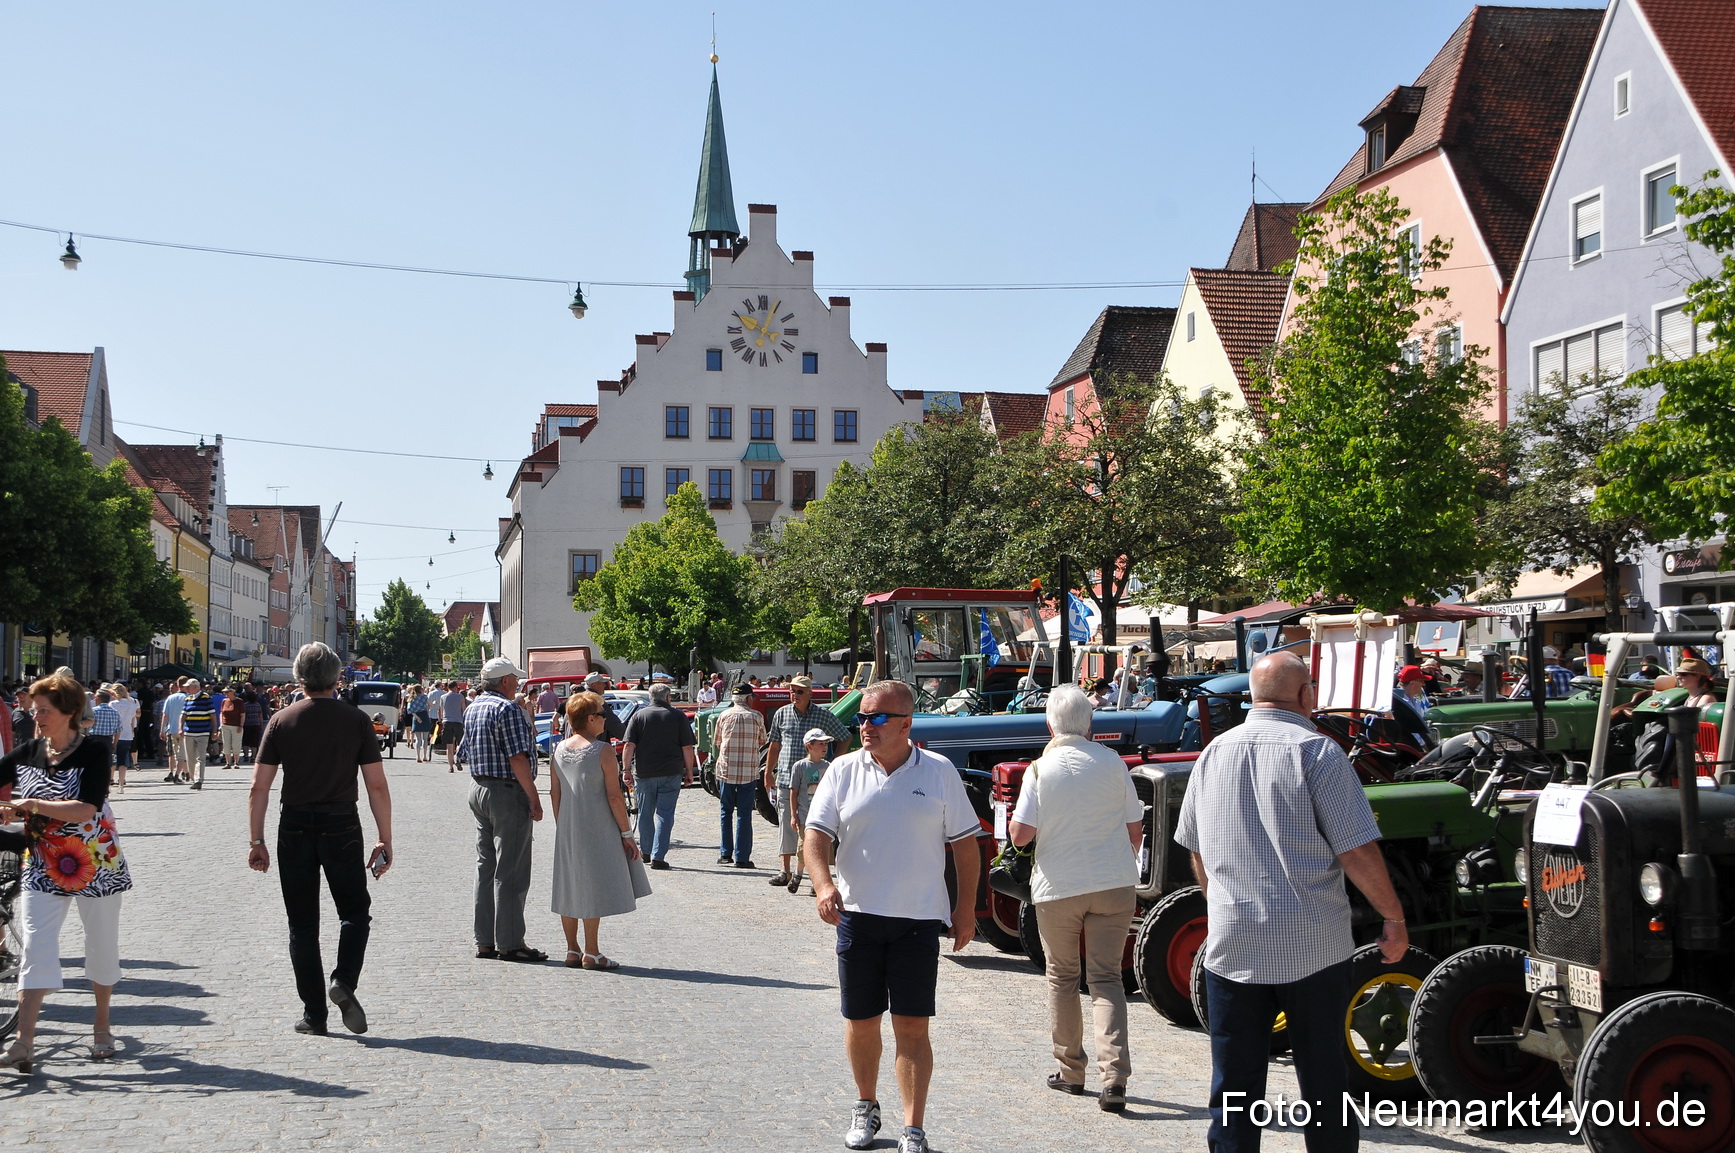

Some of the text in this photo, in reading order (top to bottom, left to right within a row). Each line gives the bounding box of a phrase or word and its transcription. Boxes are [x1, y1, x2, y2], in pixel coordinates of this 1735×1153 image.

[742, 298, 756, 314] XI
[758, 295, 768, 310] XII
[780, 312, 795, 323] II
[784, 328, 798, 336] III
[773, 349, 783, 363] V
[1555, 796, 1571, 809] 447
[1530, 961, 1541, 977] NM
